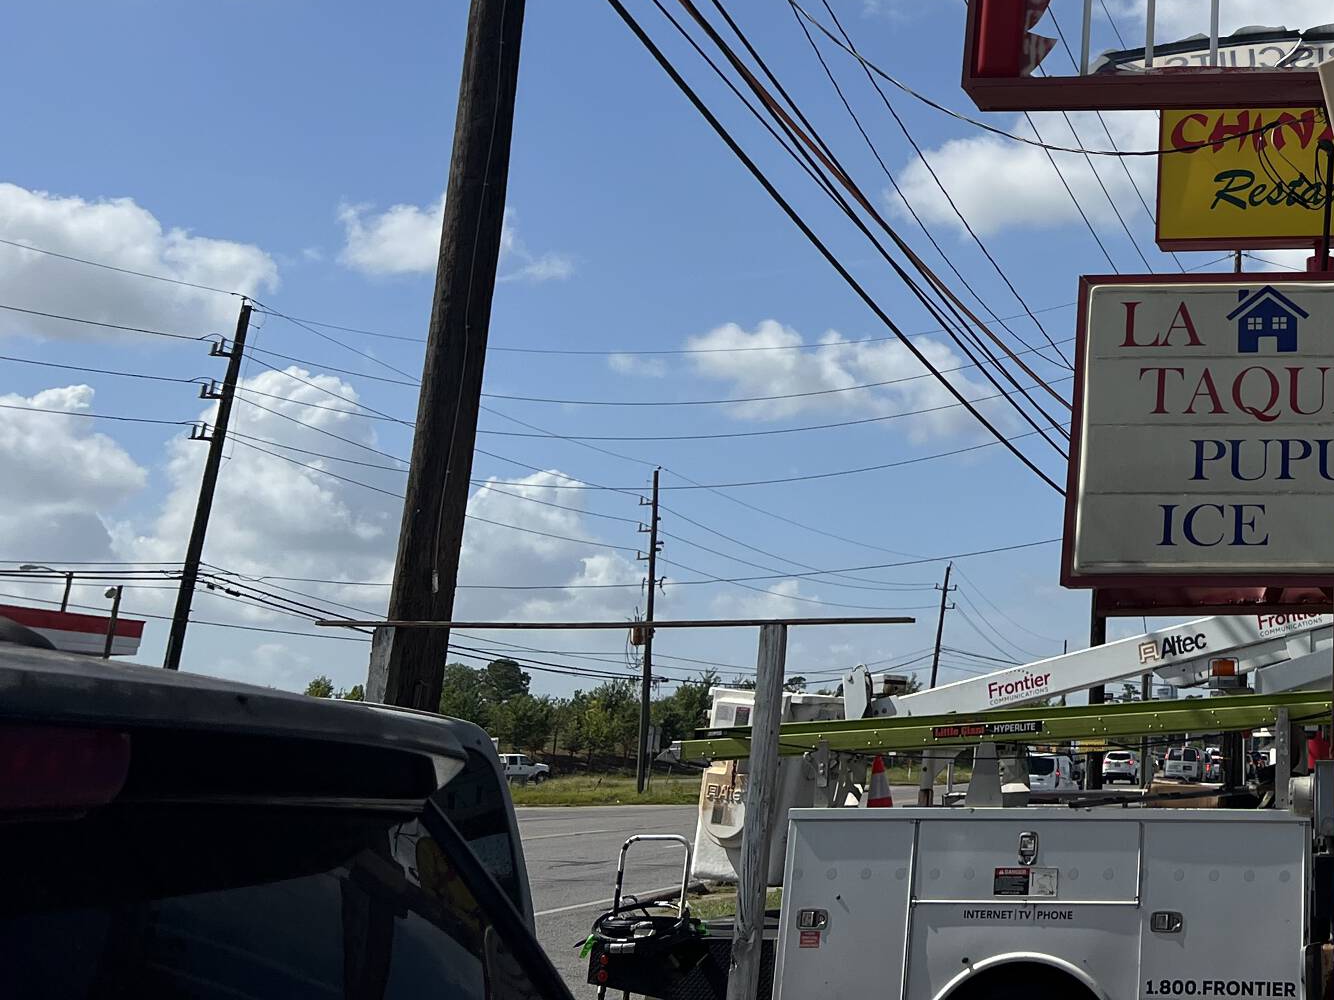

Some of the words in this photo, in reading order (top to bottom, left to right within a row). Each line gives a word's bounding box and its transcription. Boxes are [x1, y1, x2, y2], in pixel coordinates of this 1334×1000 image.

[1118, 301, 1206, 349] LA
[1156, 504, 1270, 548] ICE
[1260, 616, 1323, 637] COMMUNICATIONS
[1161, 632, 1207, 660] Altec
[988, 673, 1051, 699] Frontier
[990, 687, 1049, 706] COMMUNICATIONS
[994, 722, 1036, 733] HYPERLITE
[963, 909, 1013, 919] INTERNET
[1018, 910, 1031, 919] TV
[1036, 910, 1073, 920] PHONE
[1145, 980, 1296, 997] 1.800.FRONTIER
